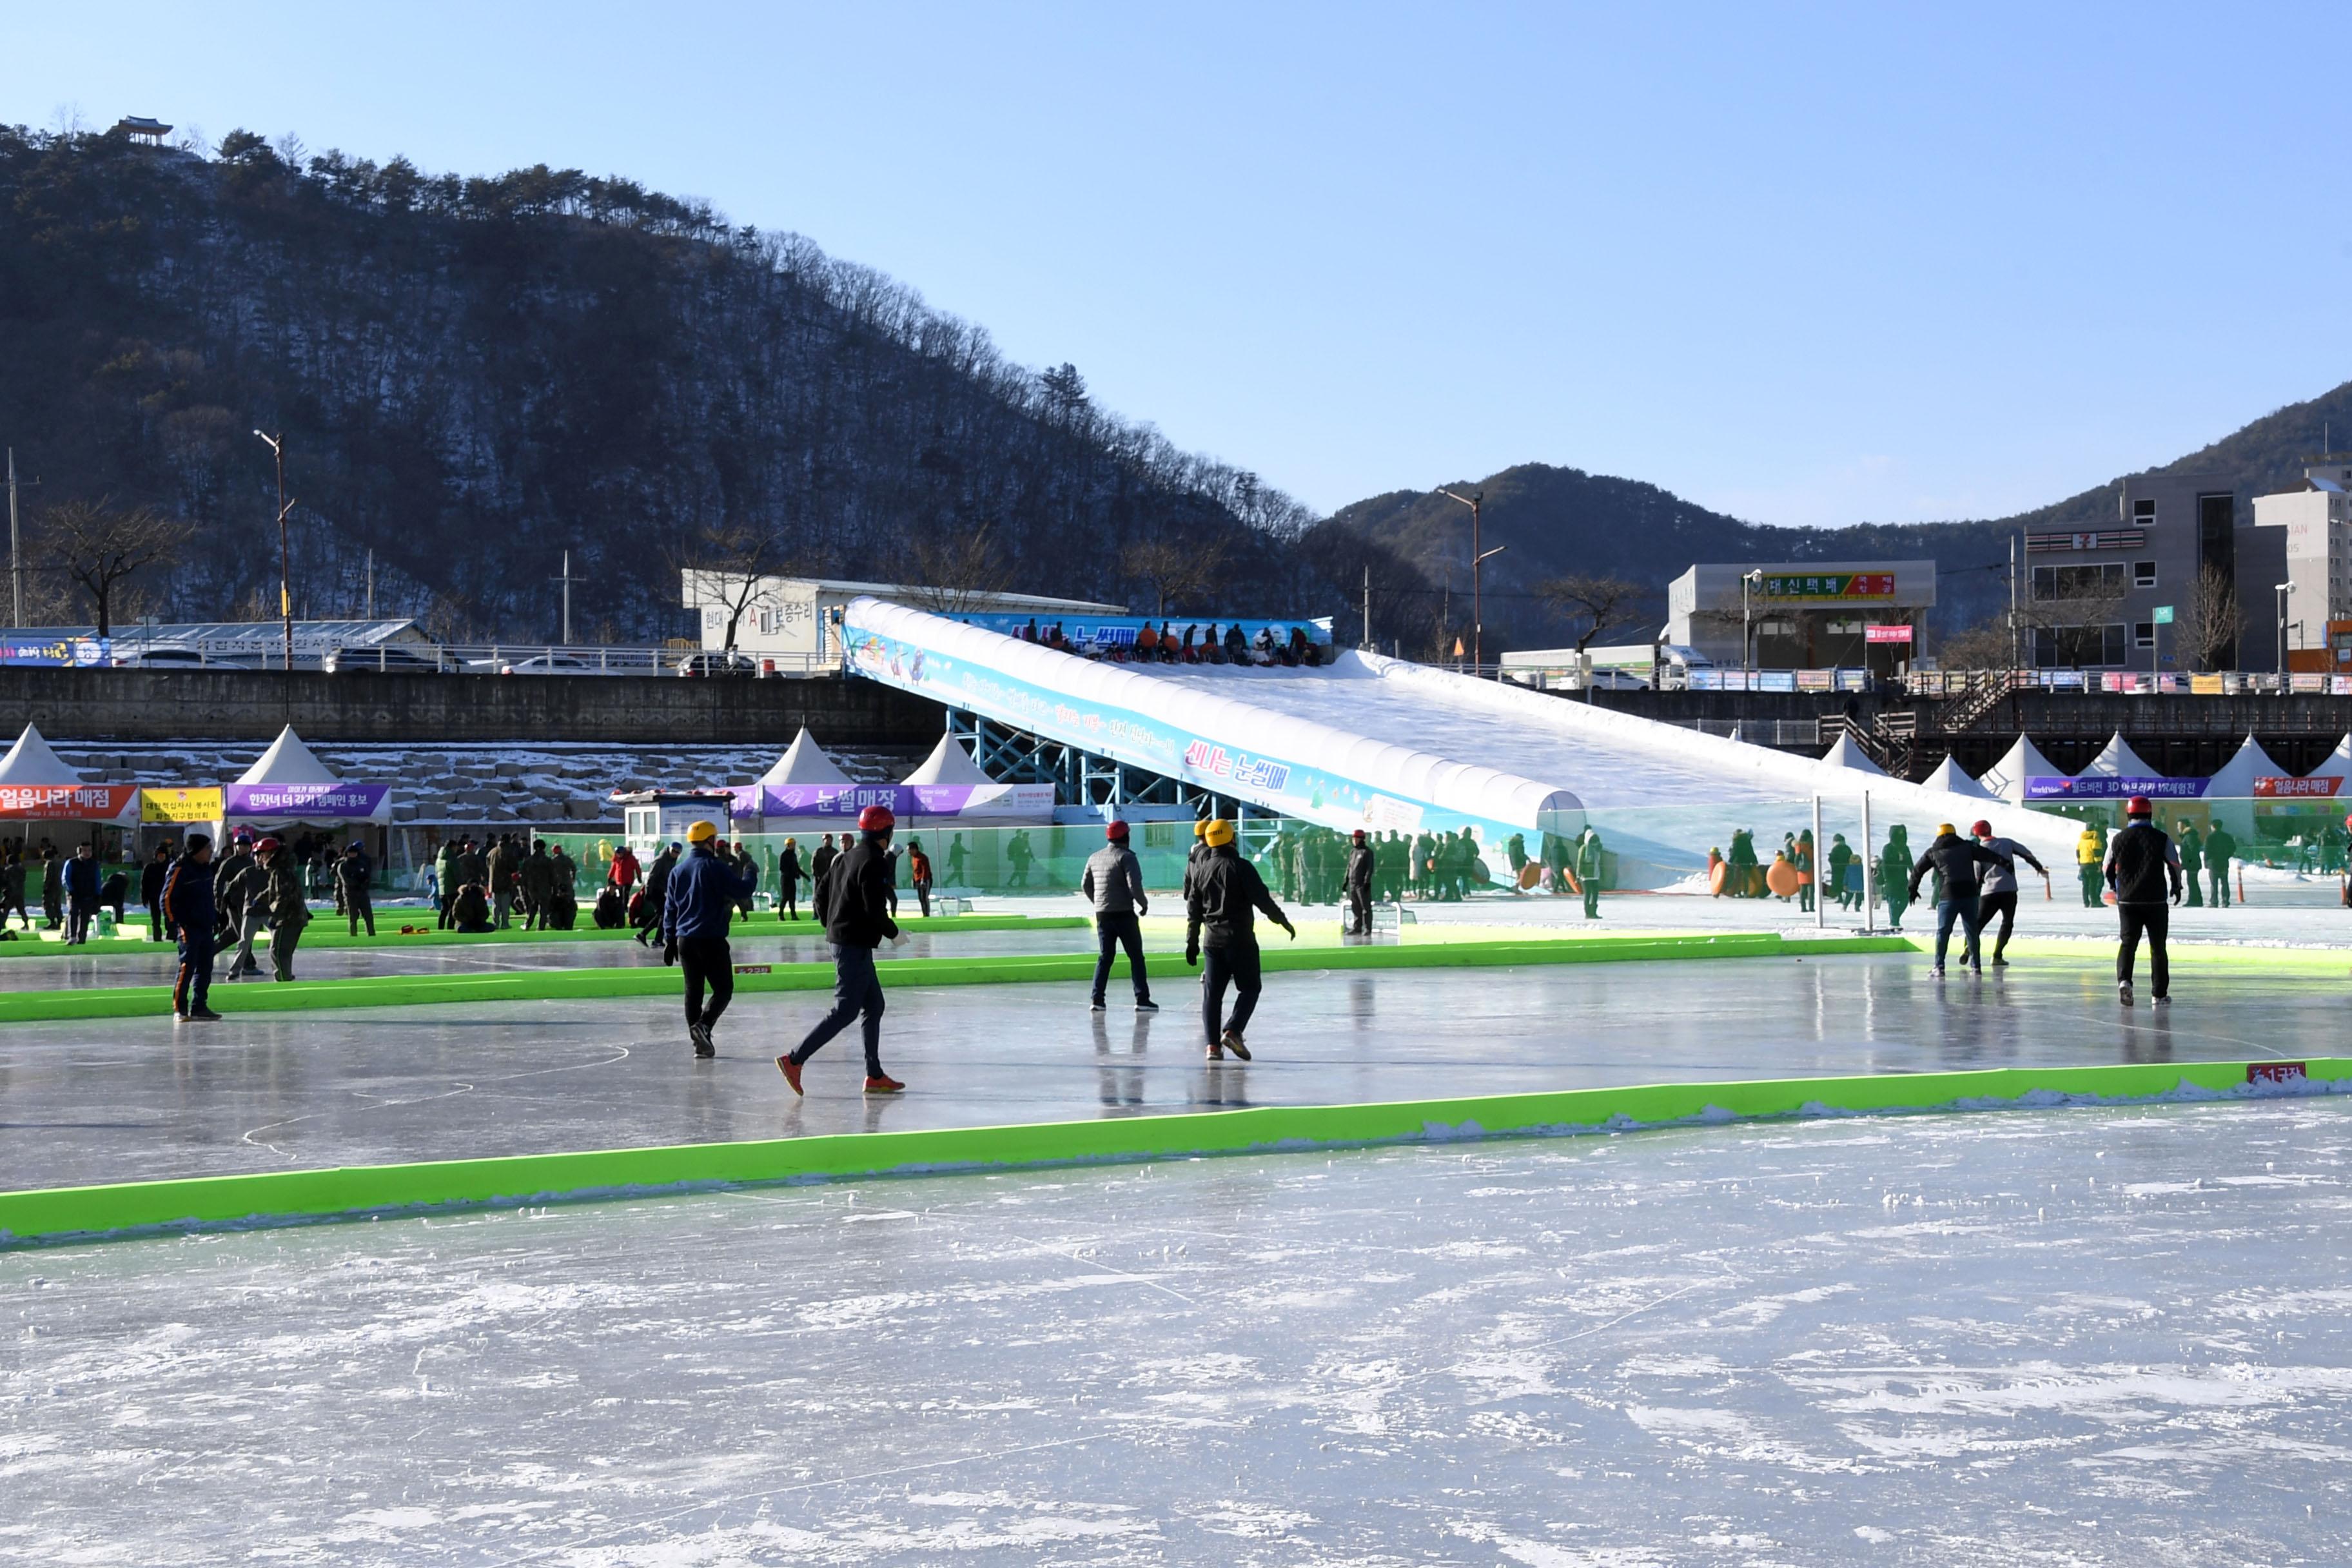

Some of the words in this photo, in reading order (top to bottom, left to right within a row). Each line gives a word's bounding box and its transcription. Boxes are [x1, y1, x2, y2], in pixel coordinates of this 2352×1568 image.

[1185, 741, 1231, 776] 신나는
[1234, 756, 1289, 790] 눈썰매
[2107, 781, 2119, 792] 3D
[2121, 781, 2156, 794] 아프리카
[2311, 779, 2329, 793] 매점
[0, 789, 72, 808] 얼음나라
[75, 789, 109, 808] 매점
[249, 794, 280, 807] 한자녀
[282, 794, 292, 807] 더
[348, 794, 368, 805] 홍보
[815, 789, 897, 812] 눈썰매장
